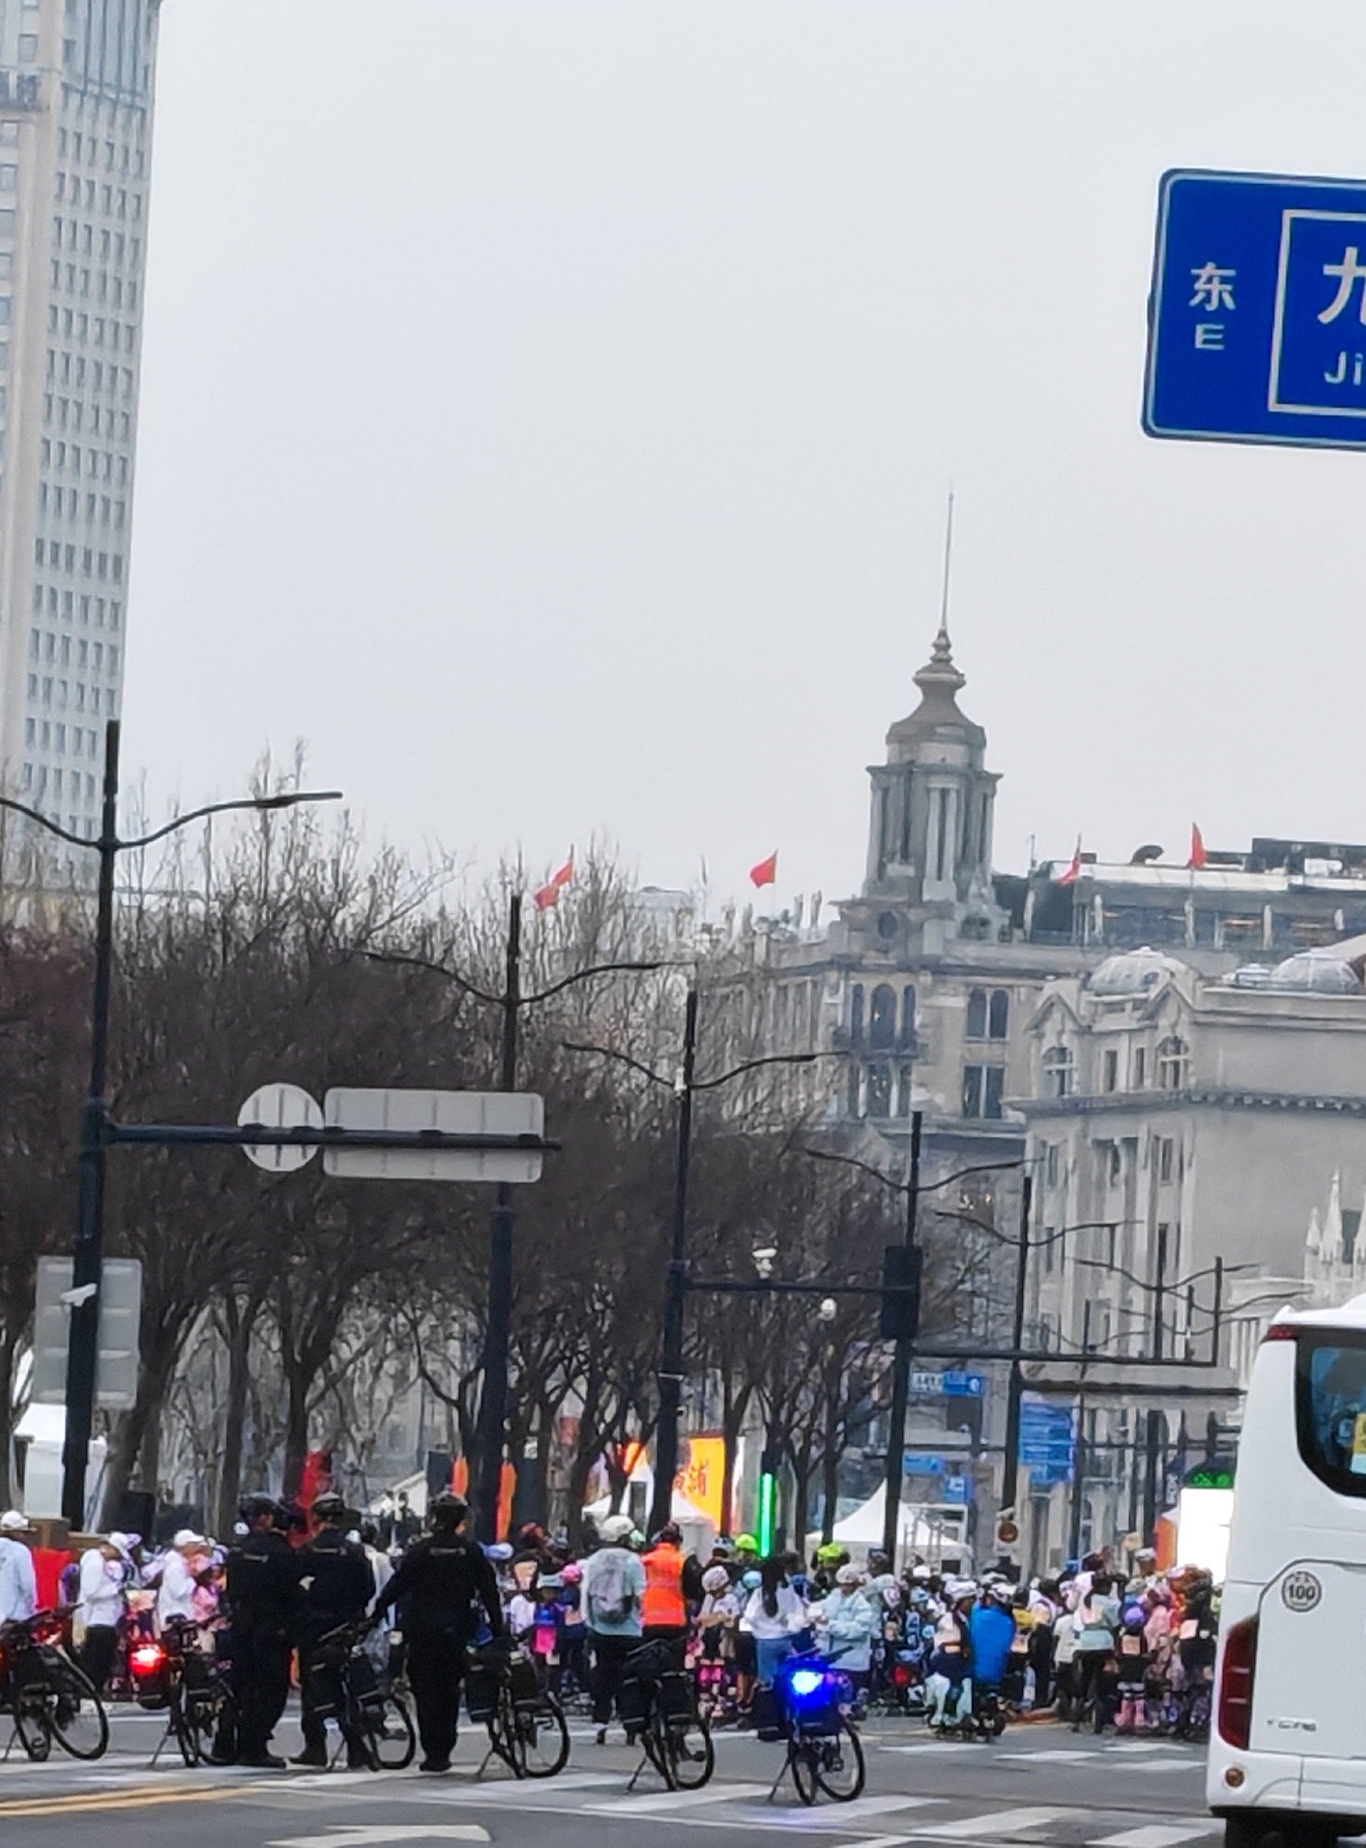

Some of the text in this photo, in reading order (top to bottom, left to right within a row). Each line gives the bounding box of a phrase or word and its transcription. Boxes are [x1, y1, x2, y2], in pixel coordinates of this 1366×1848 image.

[1190, 262, 1236, 311] 东
[1195, 323, 1225, 350] E
[1287, 1583, 1316, 1601] 100
